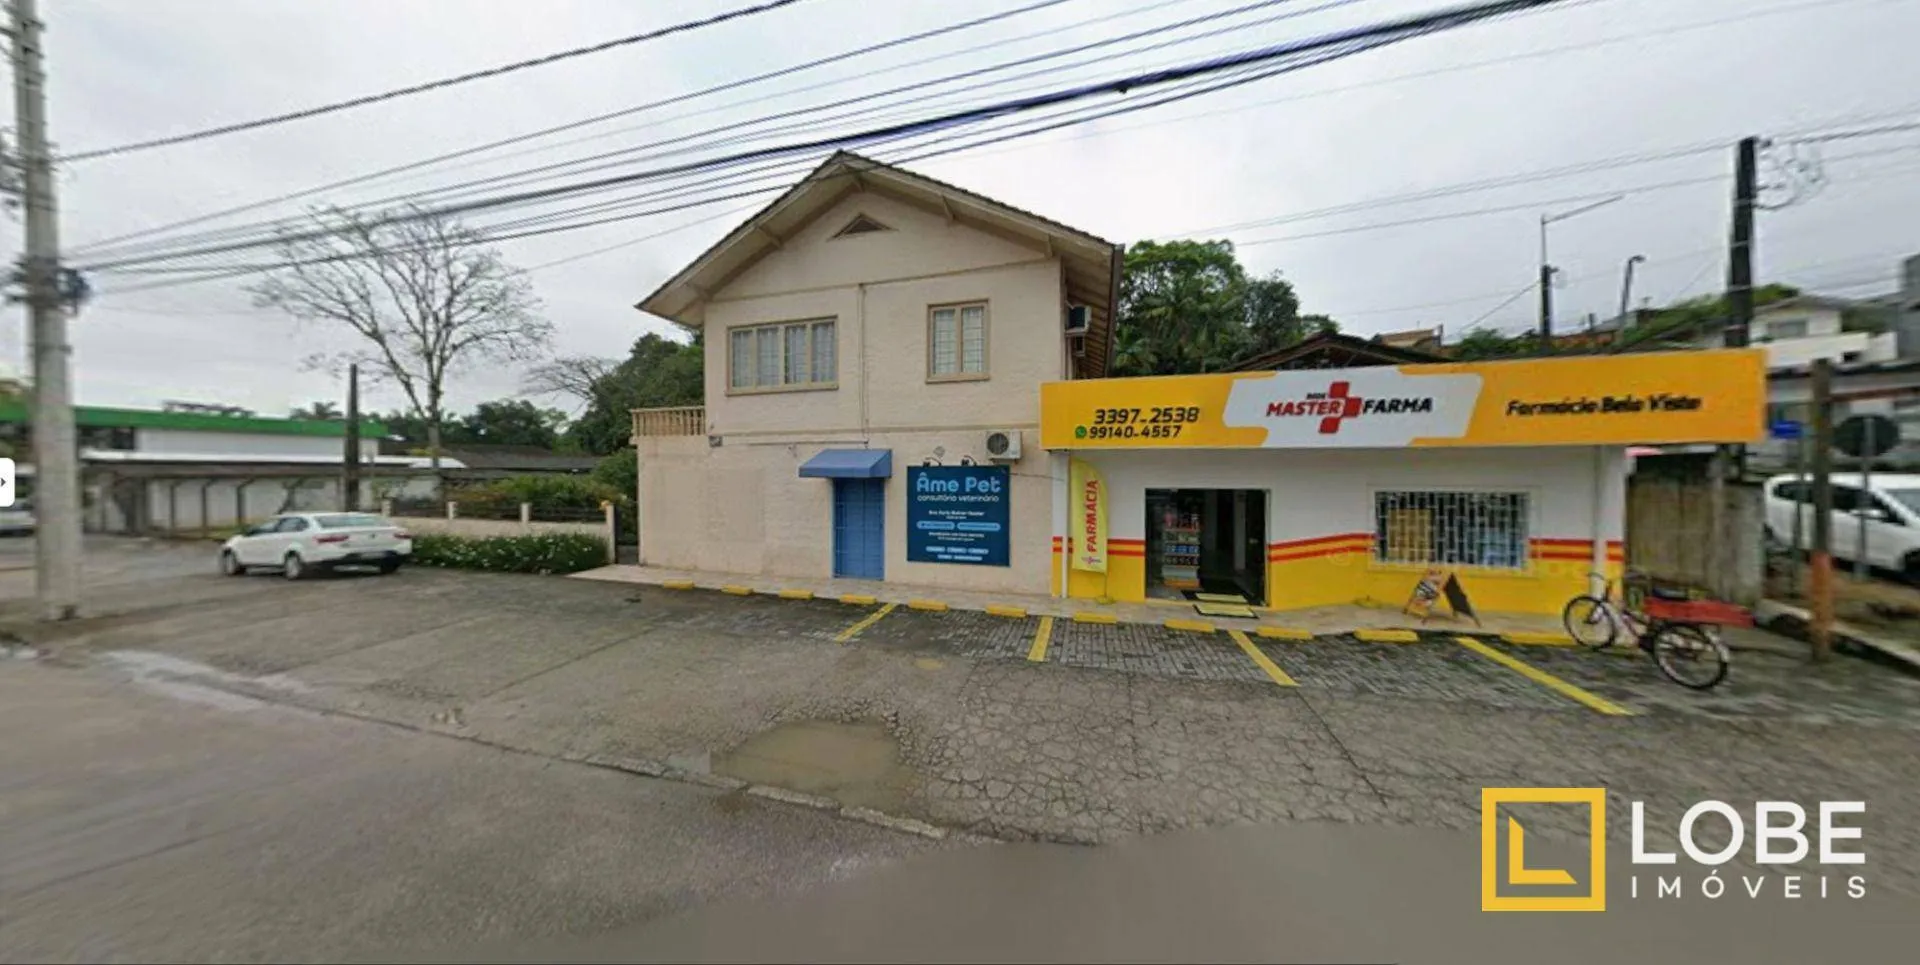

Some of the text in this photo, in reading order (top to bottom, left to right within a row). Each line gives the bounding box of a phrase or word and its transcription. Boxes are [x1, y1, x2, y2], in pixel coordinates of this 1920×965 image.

[1266, 397, 1433, 417] MASTER FARMA
[916, 472, 1001, 493] Âme Pet
